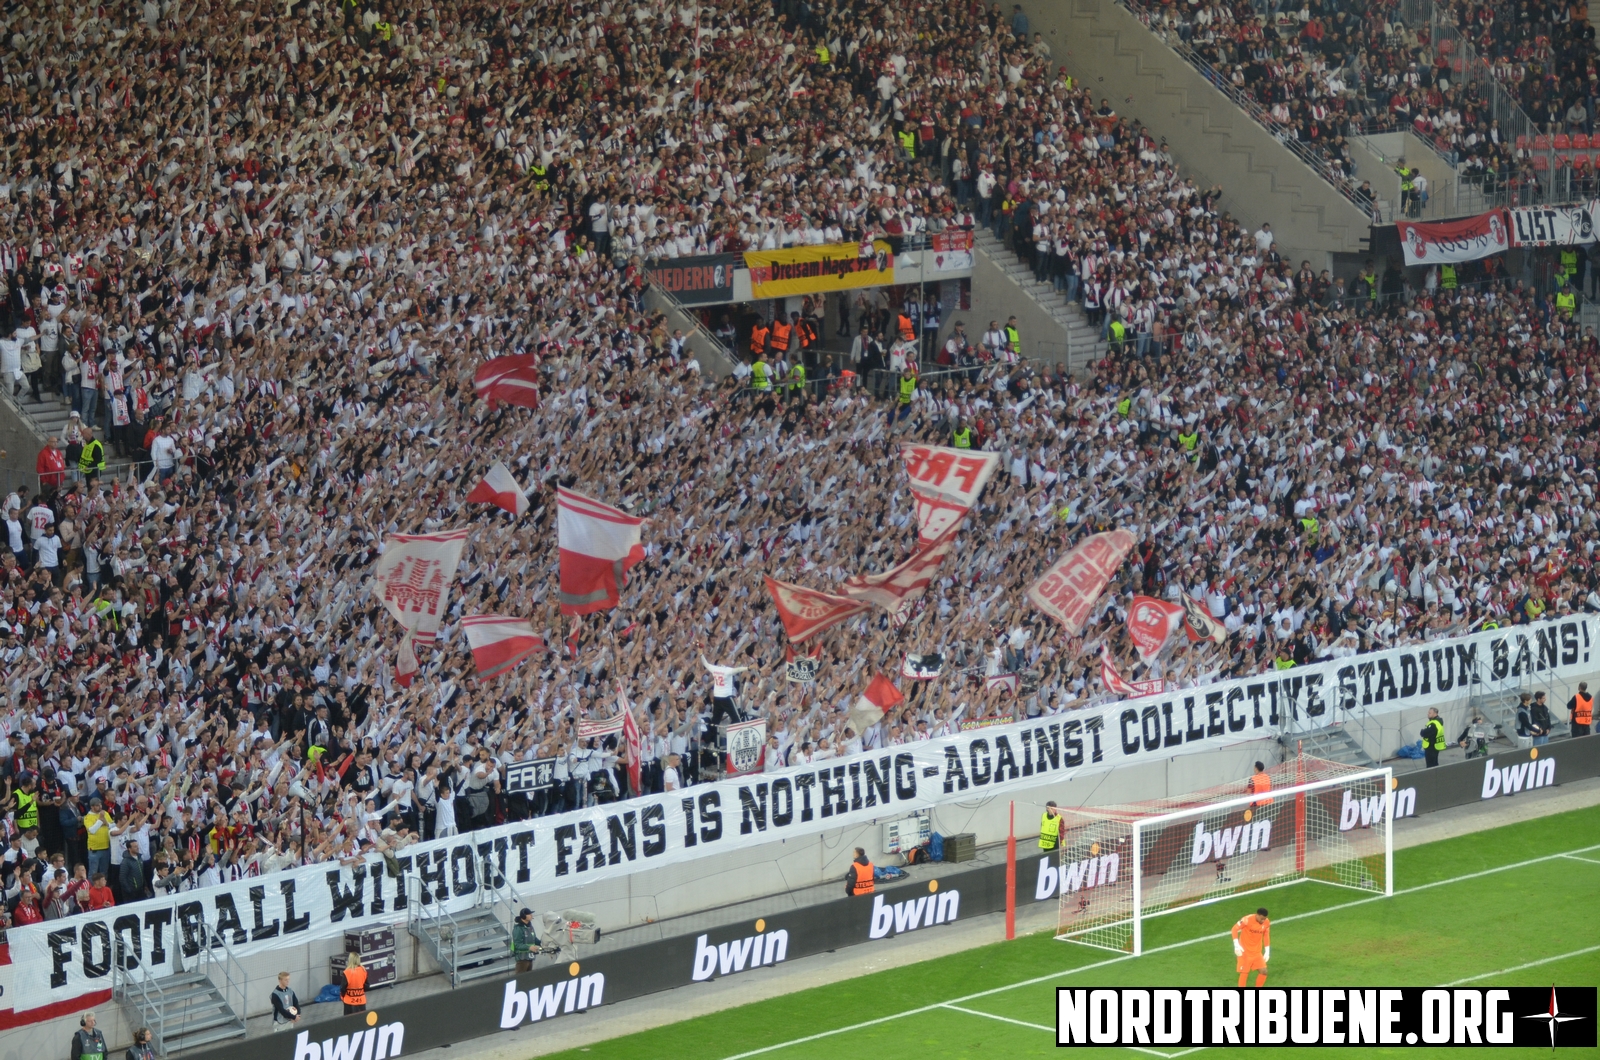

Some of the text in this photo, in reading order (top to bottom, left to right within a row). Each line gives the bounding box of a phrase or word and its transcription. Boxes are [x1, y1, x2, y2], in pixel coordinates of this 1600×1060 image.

[1516, 210, 1557, 241] LIST
[771, 258, 820, 281] Dreisam
[822, 254, 855, 280] Magic
[1482, 748, 1556, 799] bwin
[48, 879, 310, 989] FOOTBALL
[326, 830, 535, 923] WITHOUT
[554, 803, 666, 877] FANS
[682, 790, 722, 848] IS
[1120, 673, 1325, 756] COLLECTIVE
[1338, 642, 1480, 710] STADIUM
[1490, 619, 1590, 682] BANS!
[1192, 810, 1271, 864] bwin
[1036, 844, 1120, 900] bwin
[870, 880, 960, 939] bwin
[692, 919, 788, 981] bwin
[500, 962, 605, 1029] bwin
[293, 1012, 405, 1060] bwin
